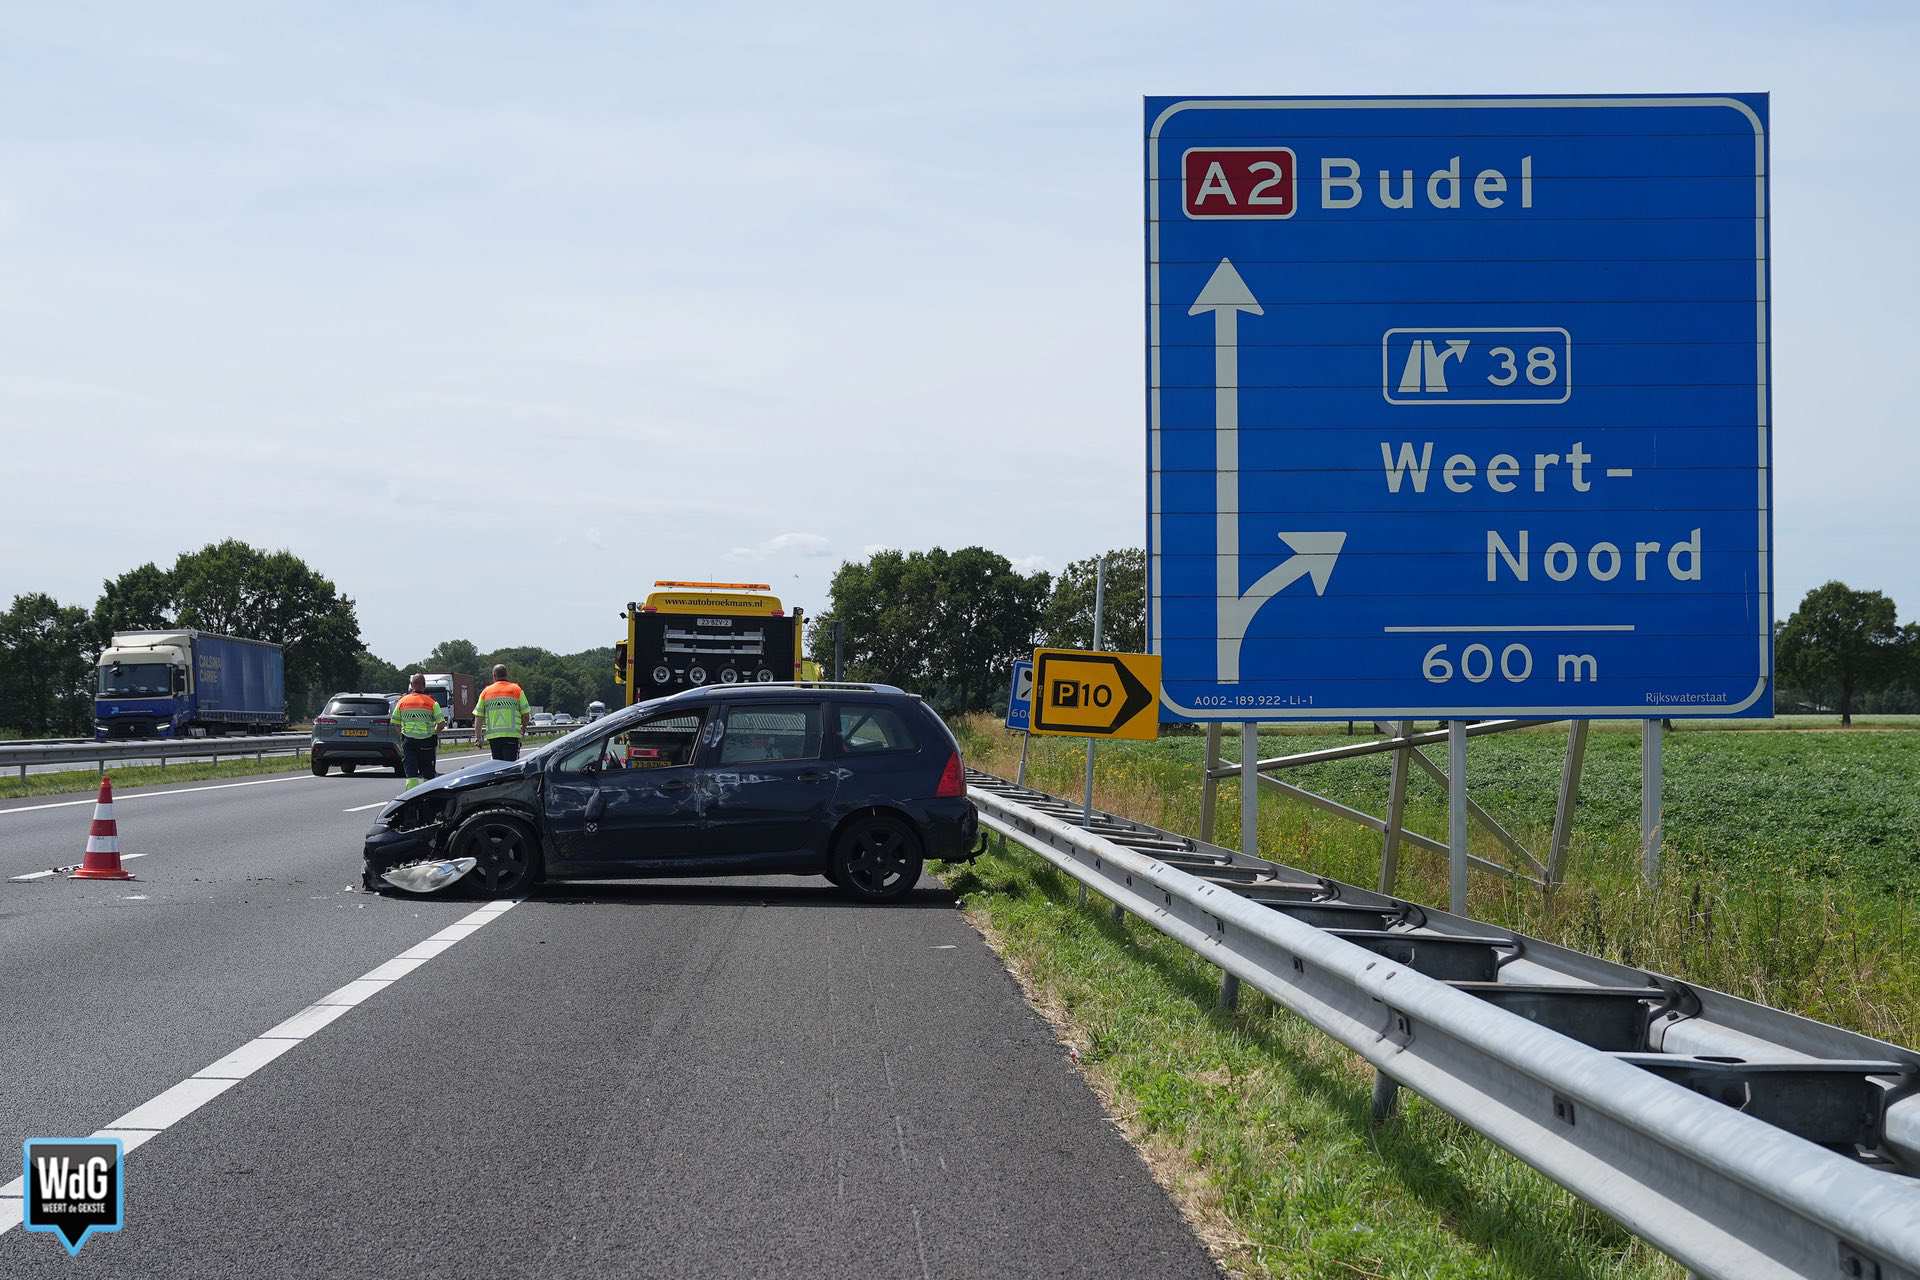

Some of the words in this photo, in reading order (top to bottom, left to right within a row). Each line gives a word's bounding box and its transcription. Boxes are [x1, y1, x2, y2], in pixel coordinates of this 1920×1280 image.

[1194, 160, 1283, 206] A2
[1320, 155, 1533, 209] Budel
[1487, 346, 1557, 386] 38
[1380, 441, 1633, 493] Weert-
[1486, 527, 1701, 582] Noord
[664, 598, 763, 608] www.autobroekmans.nl
[1422, 643, 1533, 684] 600
[1557, 654, 1598, 682] m
[1011, 708, 1030, 719] 60
[1646, 692, 1727, 705] Rijkswaterstaat
